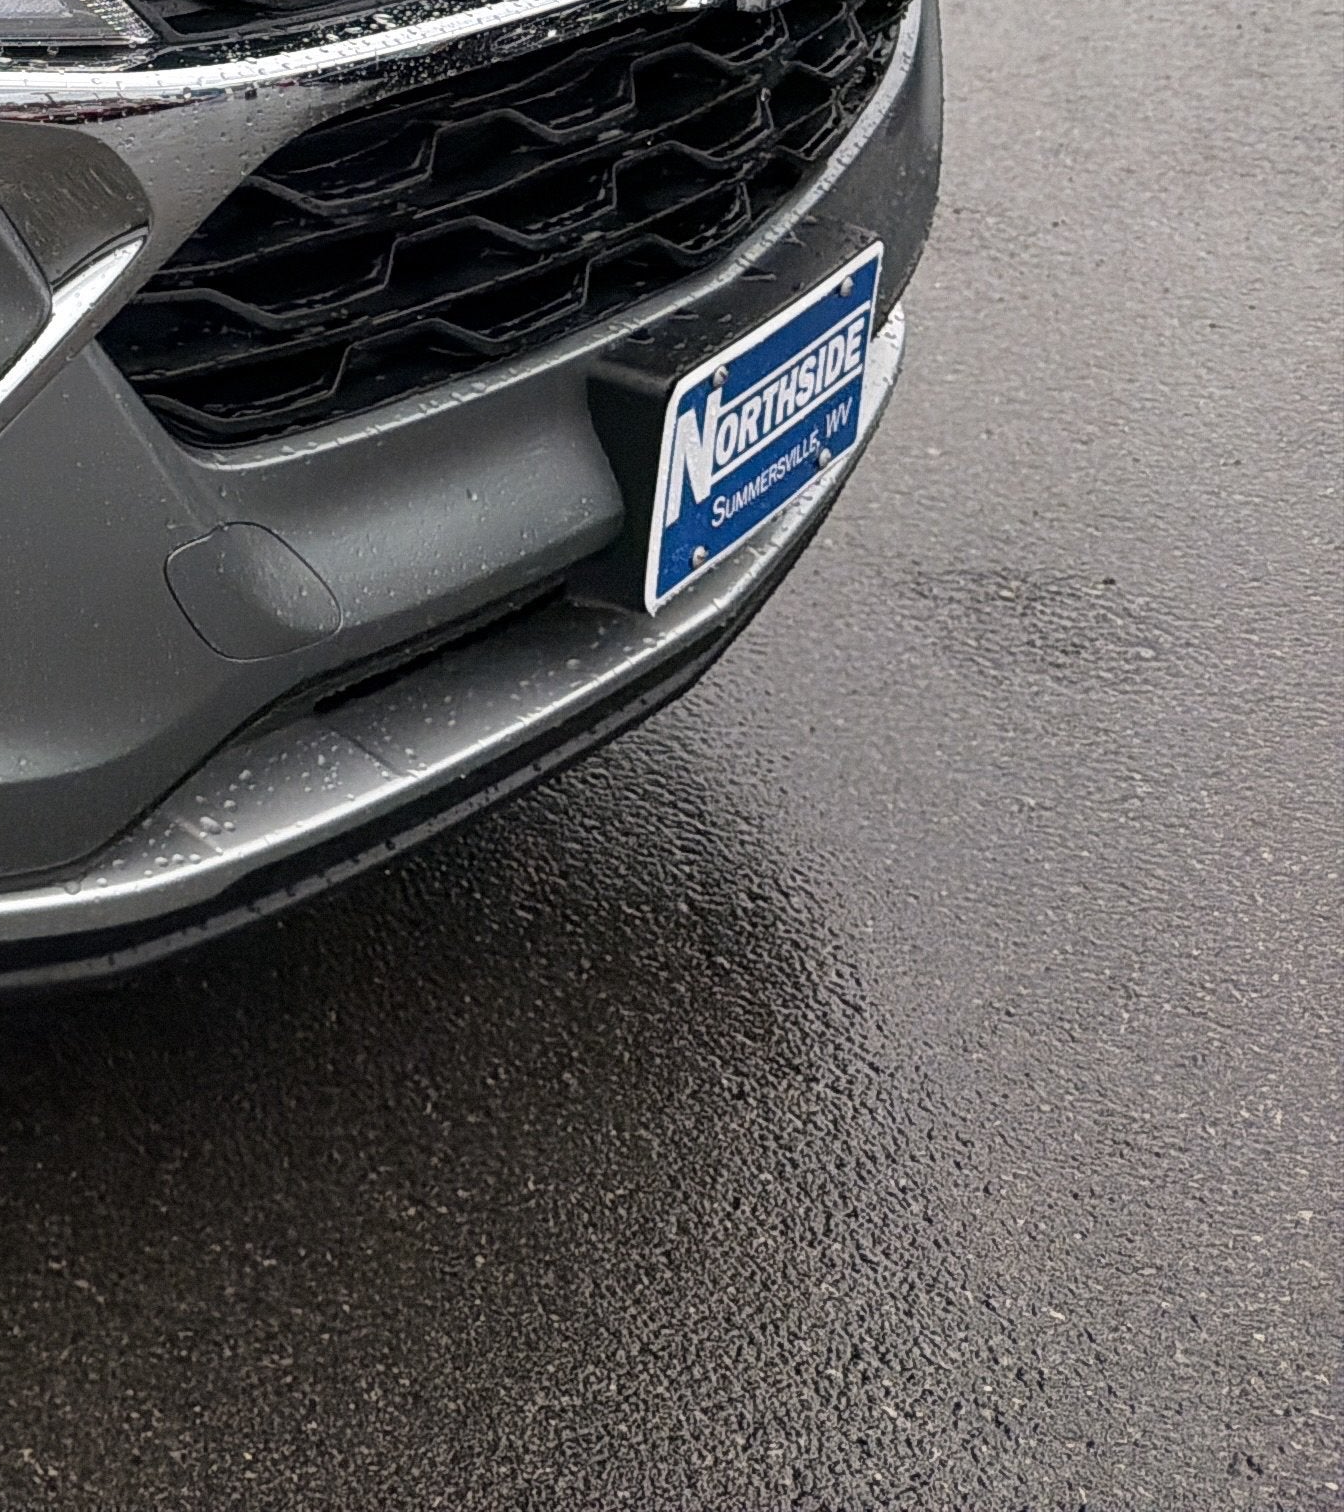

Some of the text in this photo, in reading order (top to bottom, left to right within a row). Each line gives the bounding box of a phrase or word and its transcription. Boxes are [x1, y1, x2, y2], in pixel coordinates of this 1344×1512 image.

[665, 316, 865, 528] NORTHSIDE
[711, 396, 853, 528] SUMMERSVILLE, WV
